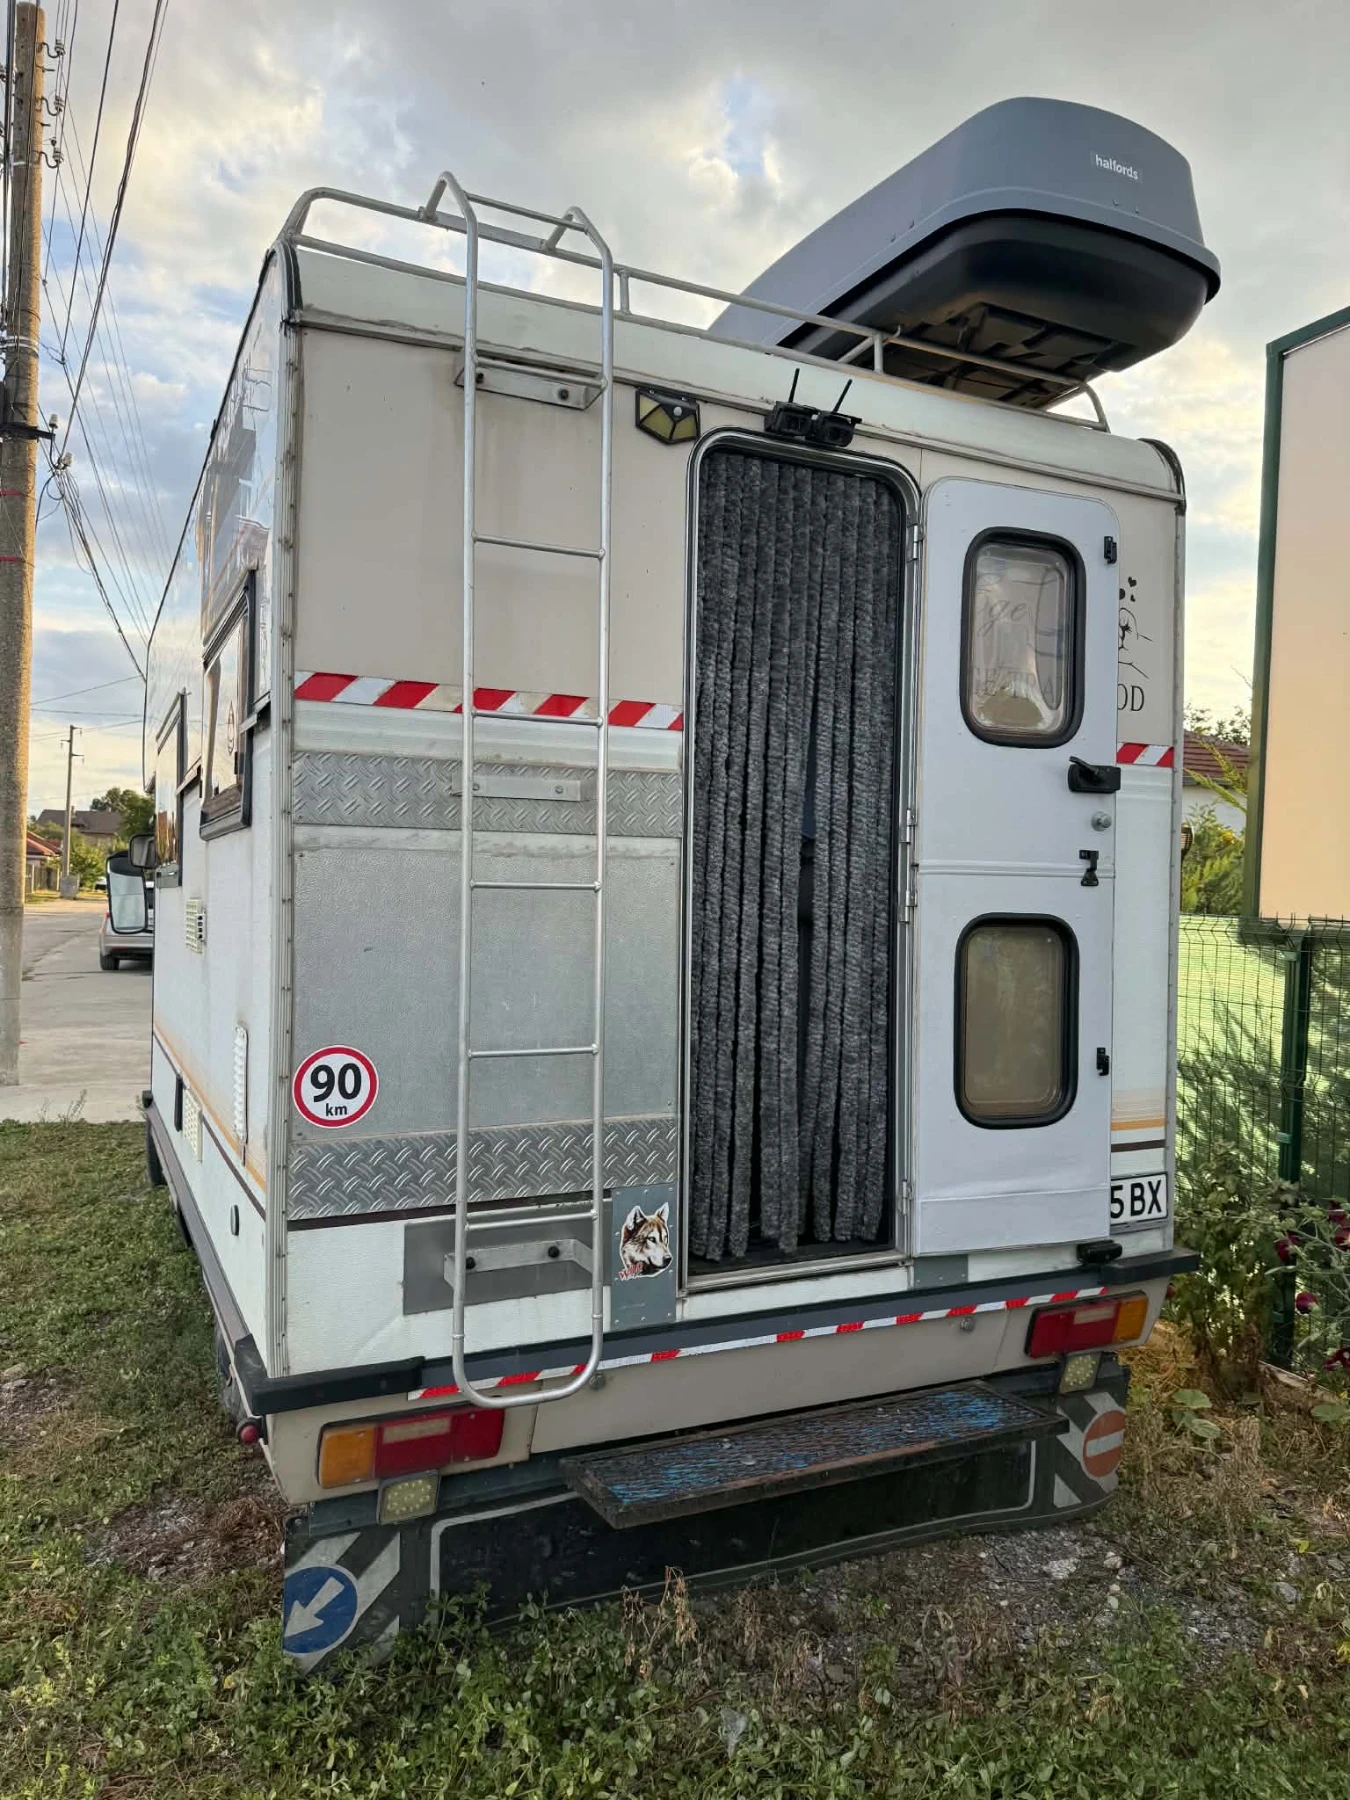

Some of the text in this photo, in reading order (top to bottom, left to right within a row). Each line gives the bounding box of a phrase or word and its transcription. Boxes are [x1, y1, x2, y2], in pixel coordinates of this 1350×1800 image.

[1095, 154, 1138, 180] halfords
[310, 1063, 362, 1103] 90
[325, 1103, 348, 1117] km
